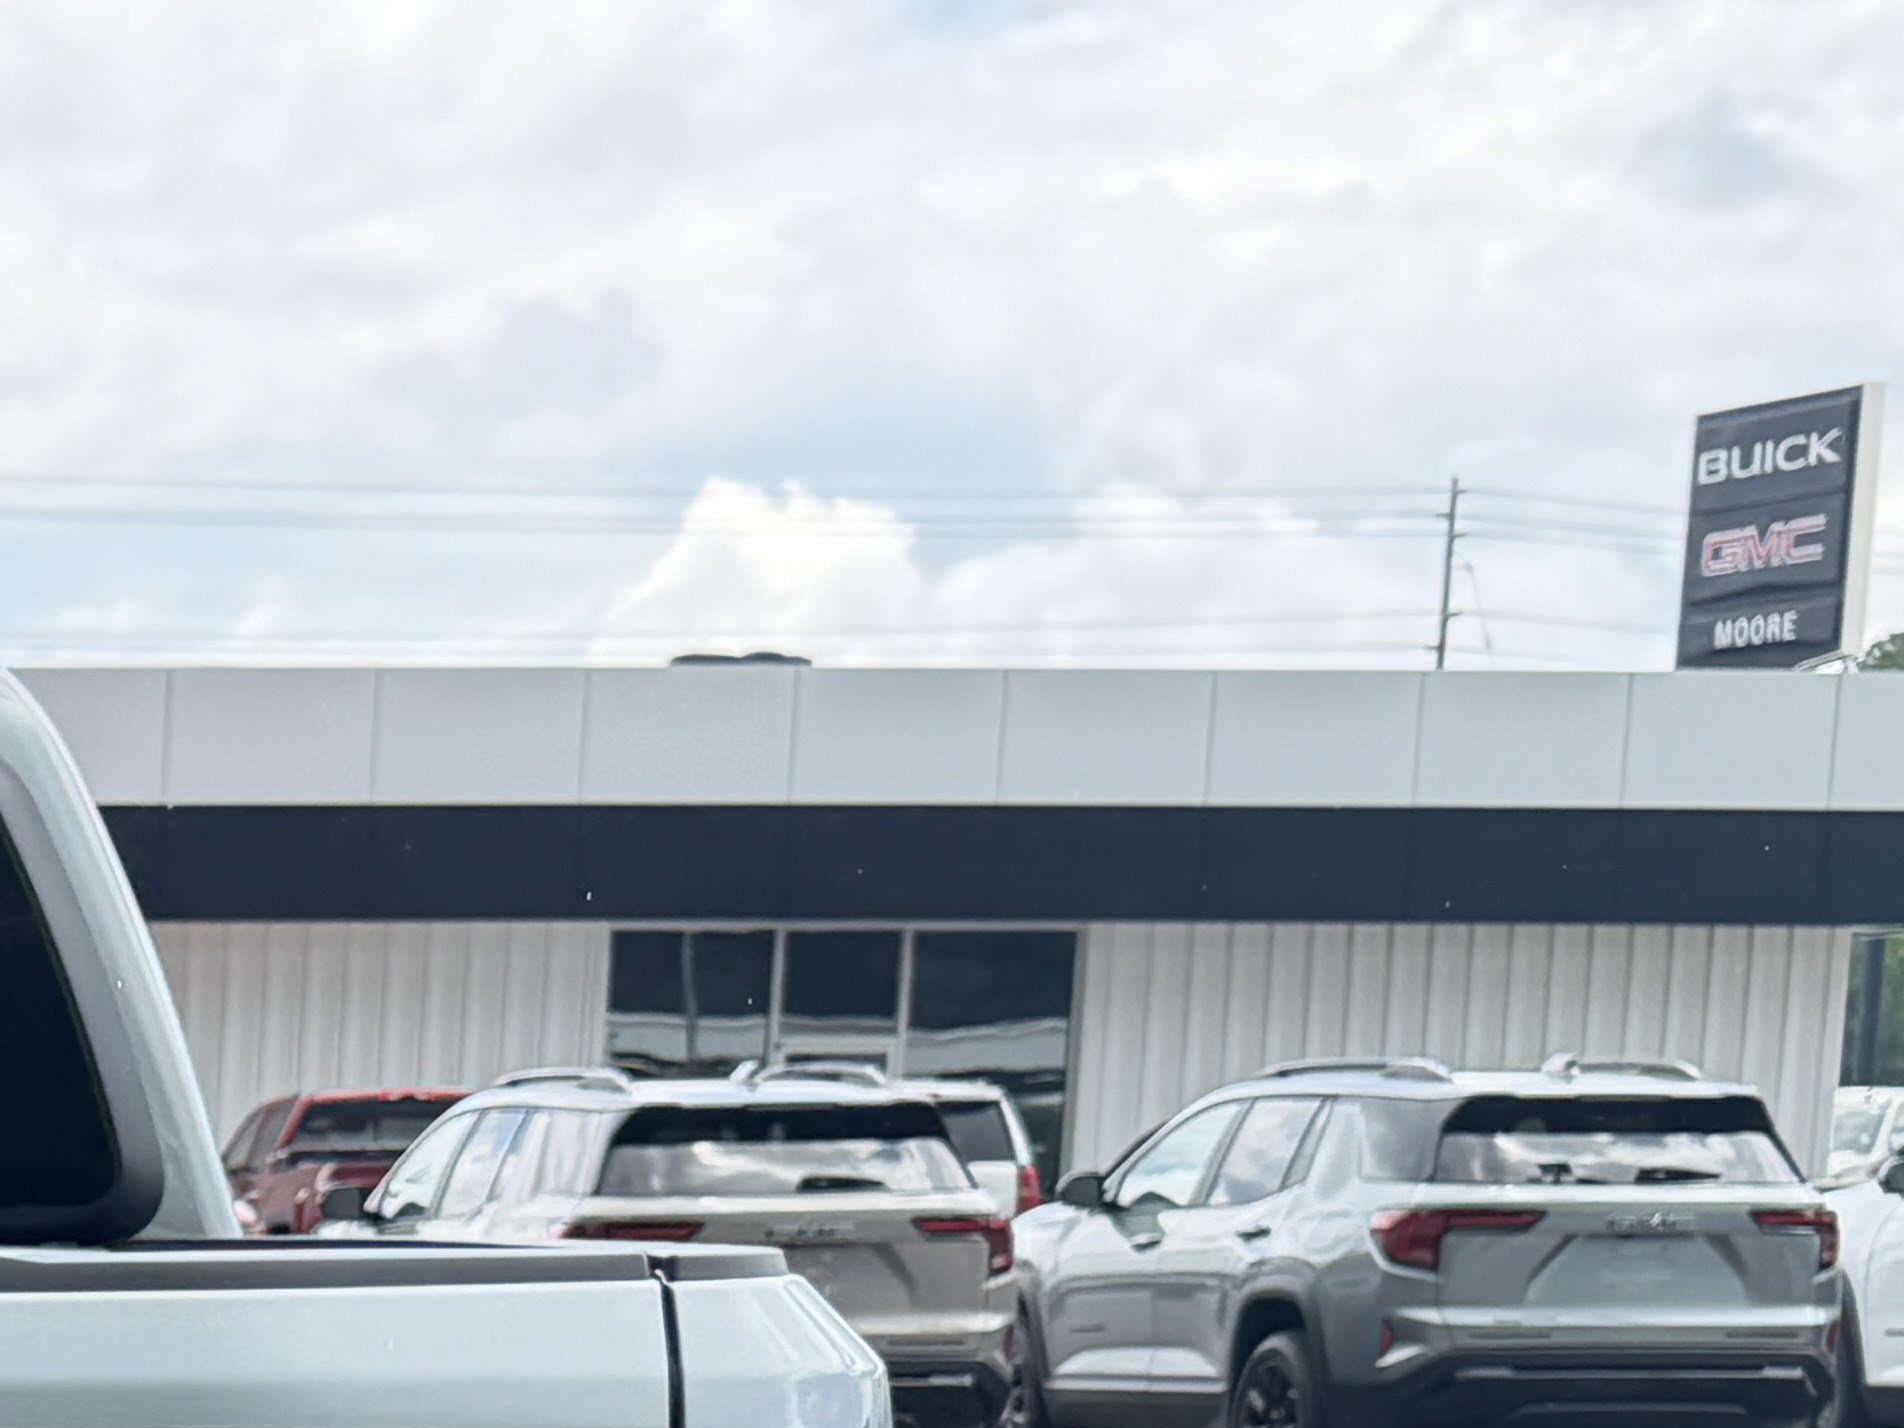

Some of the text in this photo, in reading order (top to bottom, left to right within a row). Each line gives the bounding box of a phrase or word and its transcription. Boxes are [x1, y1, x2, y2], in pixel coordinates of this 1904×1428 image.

[1696, 426, 1843, 486] BUICK
[1701, 513, 1828, 578] GMC
[1712, 610, 1798, 650] MOORE
